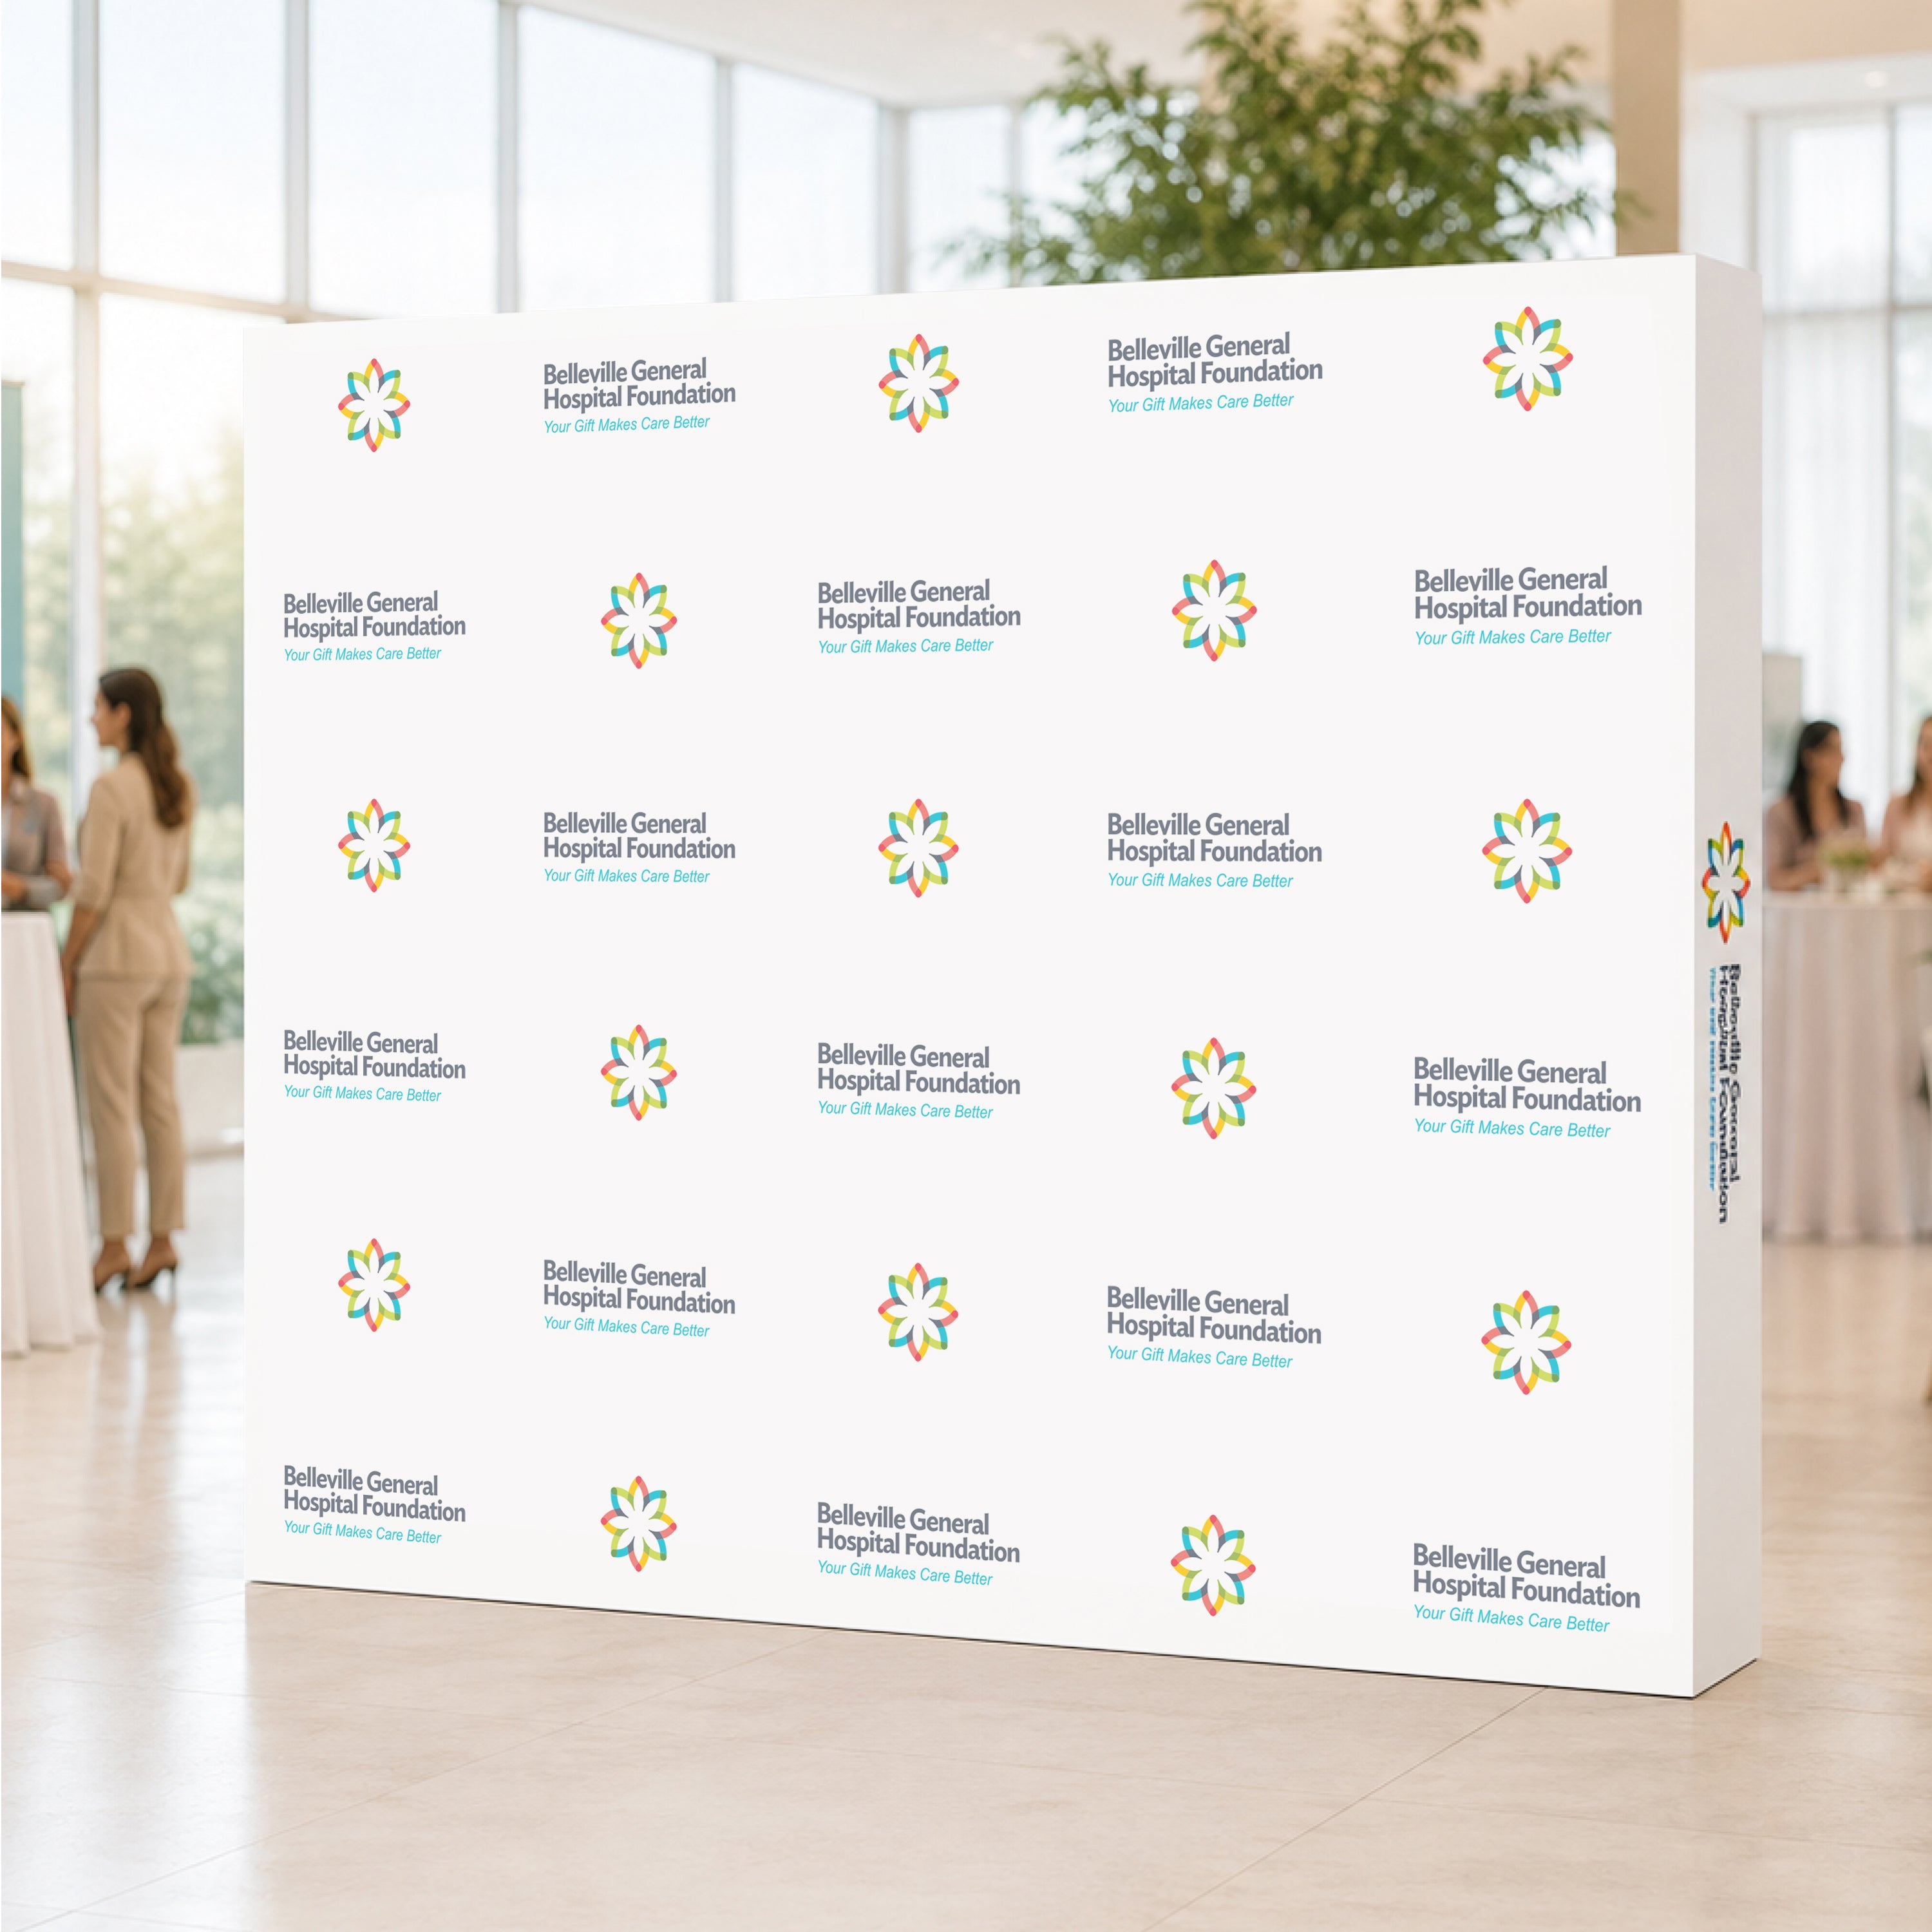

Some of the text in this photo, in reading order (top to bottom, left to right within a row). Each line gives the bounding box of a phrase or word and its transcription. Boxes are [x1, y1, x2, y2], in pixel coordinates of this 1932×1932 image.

[1108, 330, 1291, 362] Belleville General
[544, 356, 706, 385] Belleville General
[1108, 357, 1323, 393] Hospital Foundation
[544, 381, 736, 415] Hospital Foundation
[1108, 393, 1295, 413] Your Gift Makes Care Better
[544, 415, 711, 433] Your Gift Makes Care Better
[818, 578, 990, 604] Belleville General
[1415, 565, 1608, 593] Belleville General
[283, 589, 439, 614] Belleville General
[1415, 591, 1642, 625] Hospital Foundation
[284, 613, 466, 643] Hospital Foundation
[818, 603, 1021, 635] Hospital Foundation
[819, 638, 995, 654] Your Gift Makes Care Better
[1415, 628, 1613, 646] Your Gift Makes Care Better
[284, 646, 442, 662] Your Gift Makes Care Better
[544, 811, 706, 834] Belleville General
[1108, 812, 1290, 837] Belleville General
[544, 836, 736, 864] Hospital Foundation
[1108, 838, 1323, 868] Hospital Foundation
[544, 868, 711, 884] Your Gift Makes Care Better
[1108, 872, 1294, 888] Your Gift Makes Care Better
[283, 1029, 439, 1054] Belleville General
[817, 1042, 990, 1069] Belleville General
[284, 1053, 466, 1081] Hospital Foundation
[1414, 1056, 1607, 1085] Belleville General
[284, 1084, 442, 1103] Your Gift Makes Care Better
[817, 1067, 1021, 1097] Hospital Foundation
[818, 1100, 994, 1119] Your Gift Makes Care Better
[1414, 1083, 1642, 1114] Hospital Foundation
[1414, 1117, 1612, 1139] Your Gift Makes Care Better
[544, 1259, 706, 1289] Belleville General
[544, 1283, 735, 1314] Hospital Foundation
[1107, 1285, 1289, 1316] Belleville General
[544, 1315, 710, 1338] Your Gift Makes Care Better
[1107, 1311, 1321, 1345] Hospital Foundation
[1108, 1345, 1294, 1368] Your Gift Makes Care Better
[284, 1464, 439, 1497] Belleville General
[284, 1488, 466, 1522] Hospital Foundation
[817, 1501, 989, 1535] Belleville General
[284, 1519, 442, 1544] Your Gift Makes Care Better
[817, 1526, 1020, 1564] Hospital Foundation
[818, 1559, 994, 1586] Your Gift Makes Care Better
[1413, 1542, 1606, 1579] Belleville General
[1414, 1569, 1641, 1609] Hospital Foundation
[1414, 1604, 1611, 1633] Your Gift Makes Care Better
